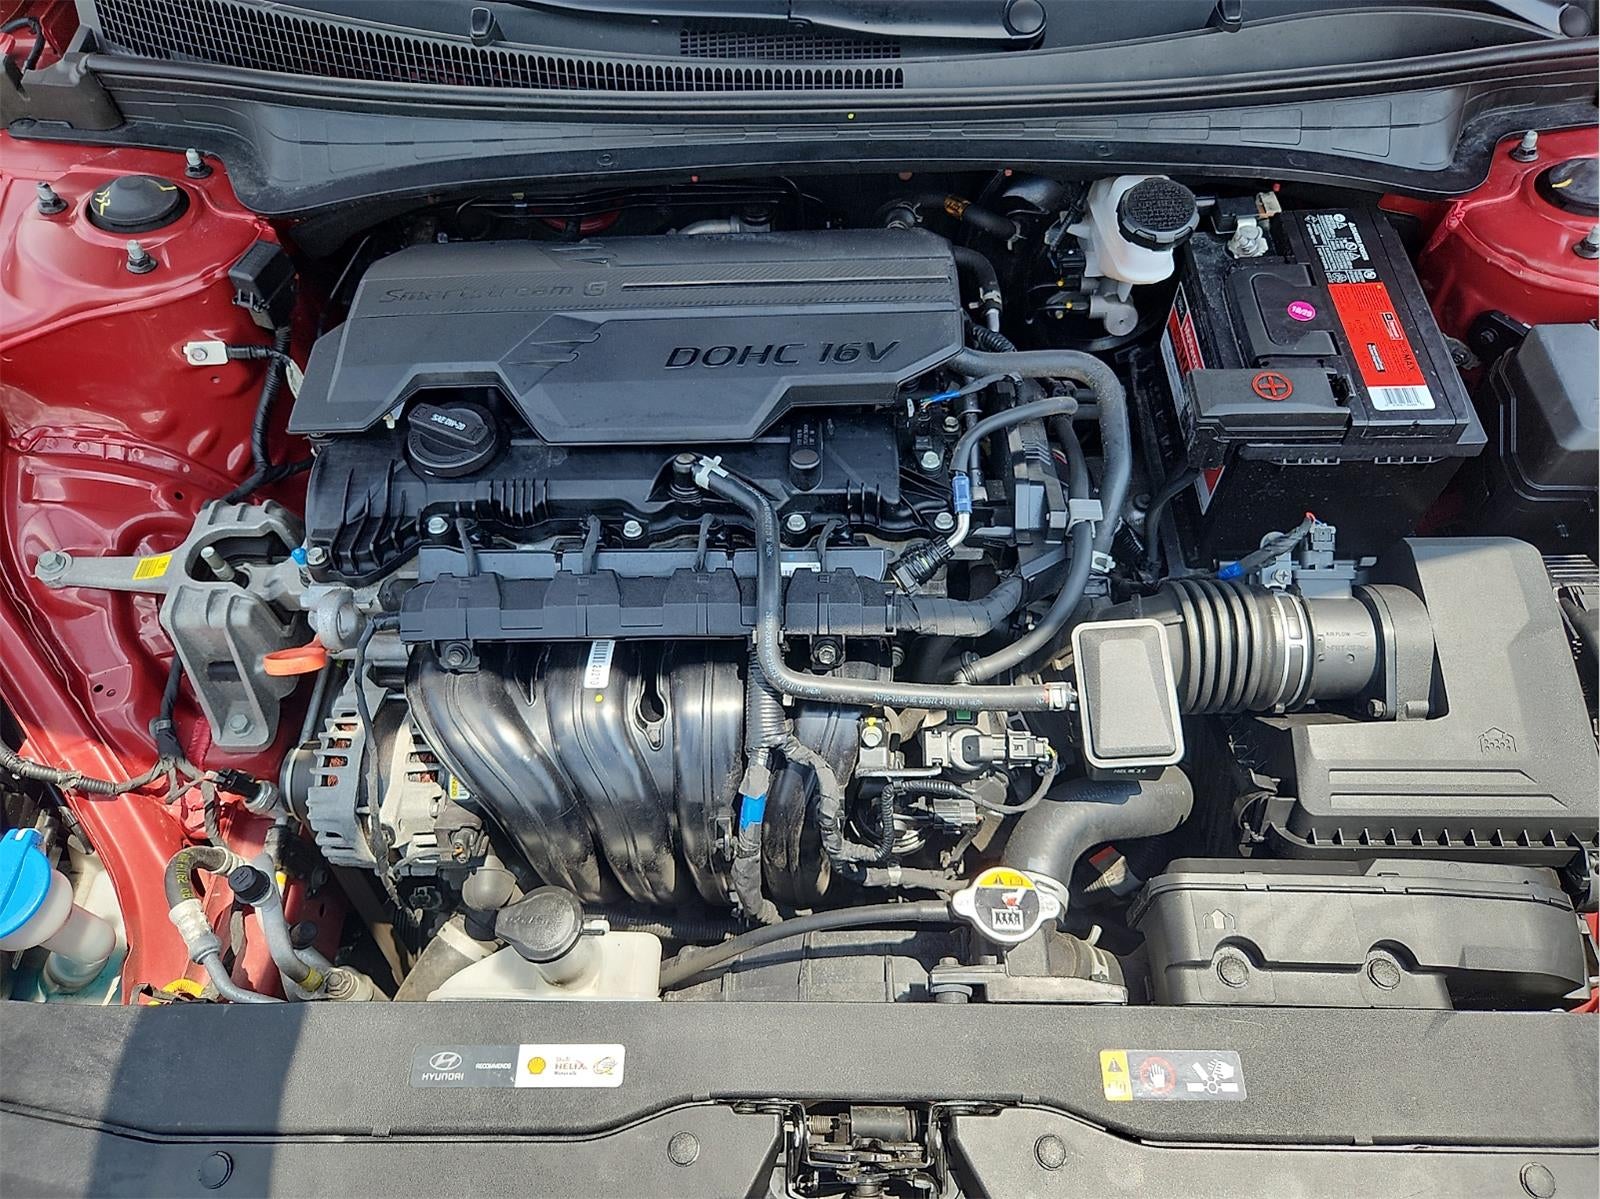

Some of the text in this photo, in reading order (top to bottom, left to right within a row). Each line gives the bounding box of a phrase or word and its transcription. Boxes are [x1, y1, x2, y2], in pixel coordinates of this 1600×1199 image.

[379, 285, 574, 304] Smartstream
[664, 340, 900, 369] DOHC 16V
[421, 1071, 465, 1081] HYUNDAI
